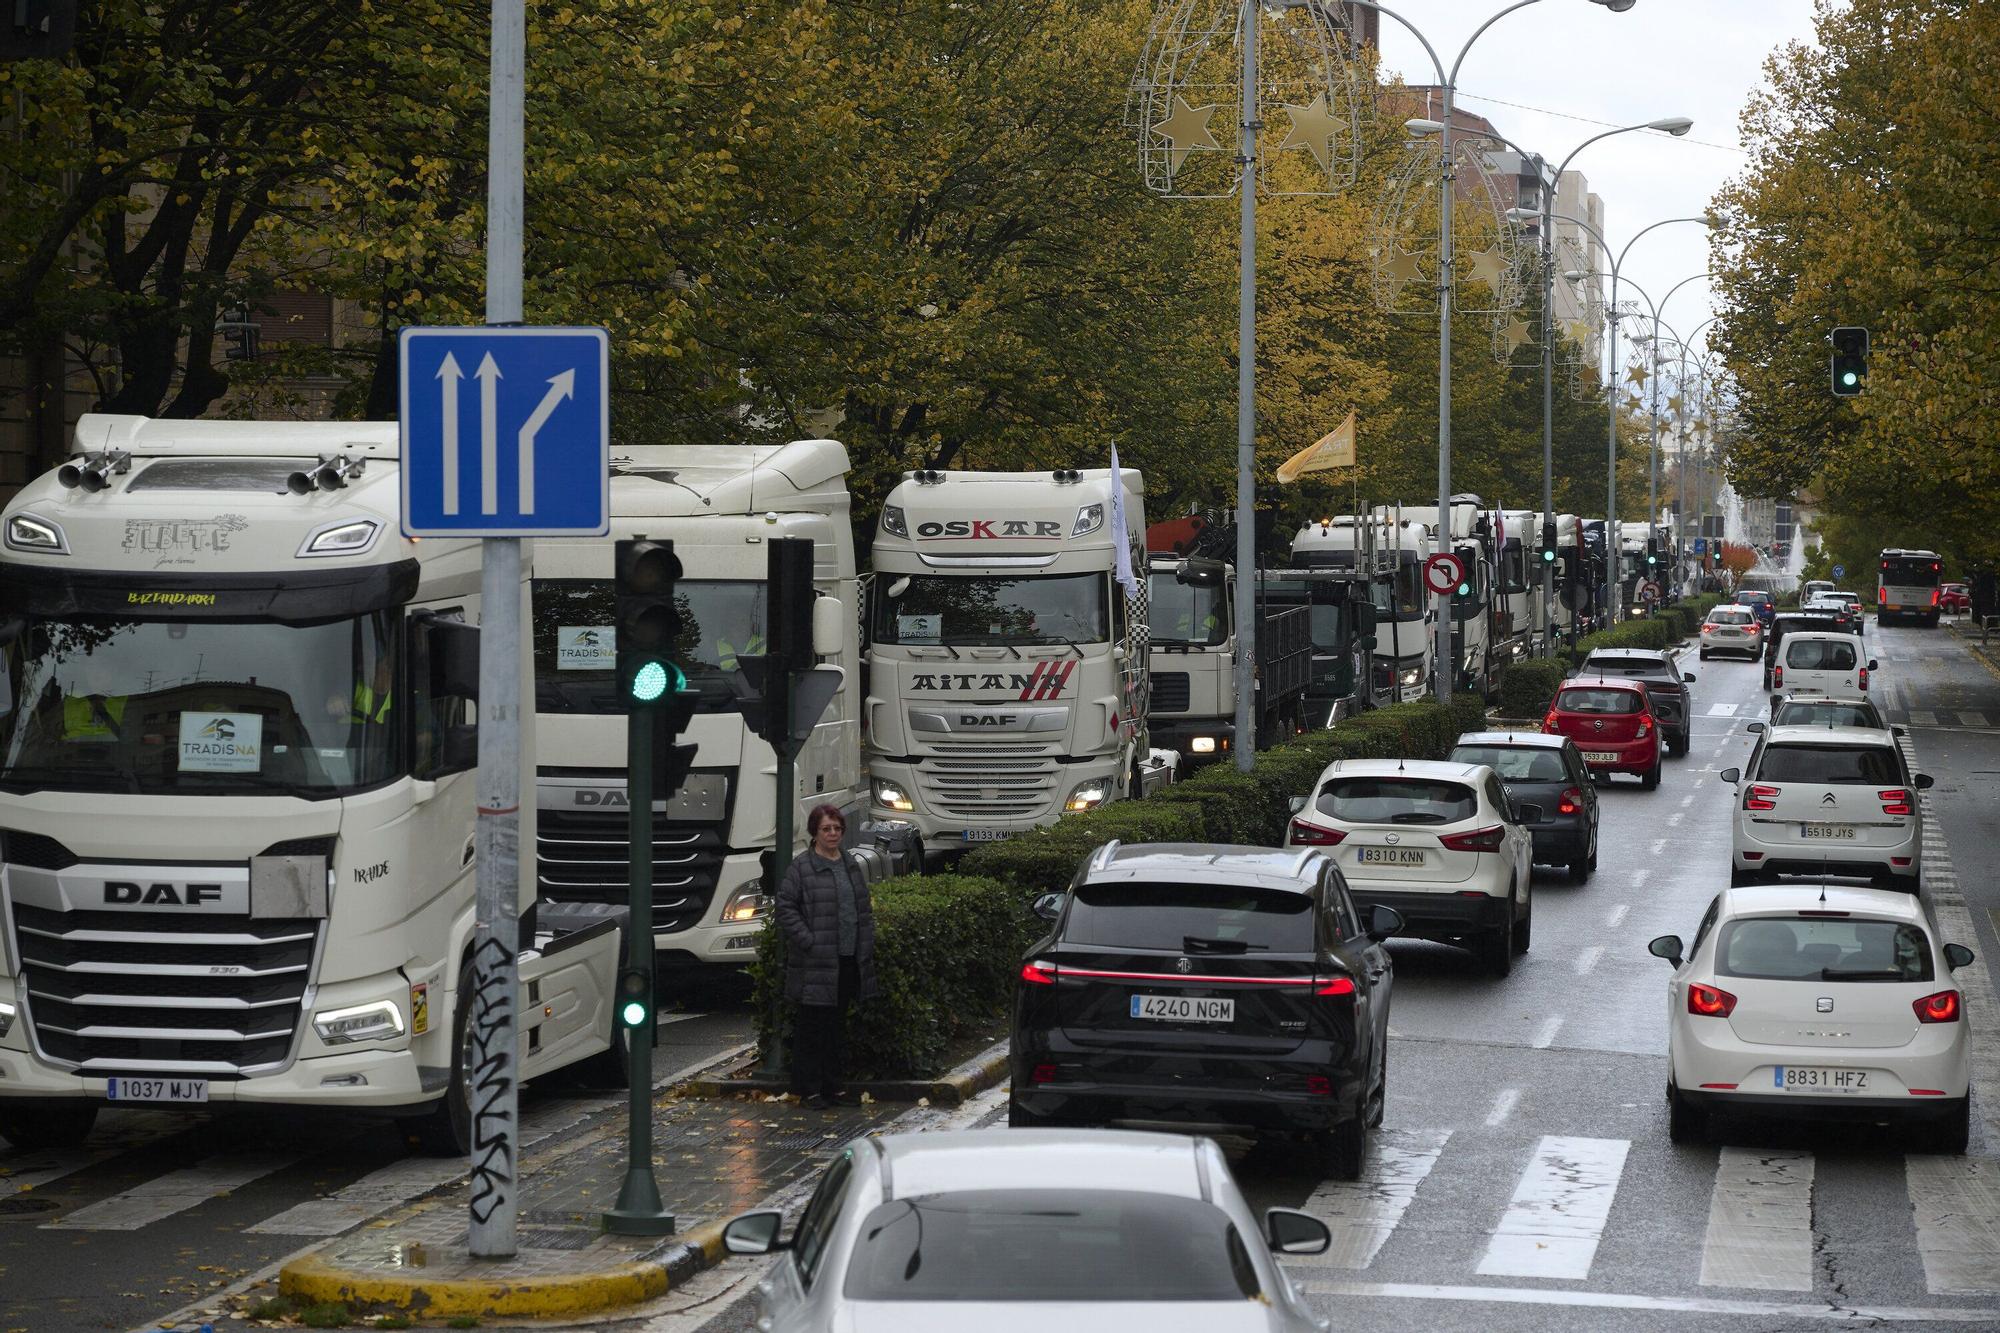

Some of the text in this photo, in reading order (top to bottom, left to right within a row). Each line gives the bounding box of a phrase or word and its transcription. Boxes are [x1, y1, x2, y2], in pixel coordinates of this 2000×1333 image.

[917, 520, 1061, 539] OSKAR
[960, 716, 1017, 726] DAF
[575, 790, 629, 806] DA
[969, 830, 993, 840] 9133
[1807, 827, 1854, 838] 5519 JYS
[1366, 850, 1424, 863] 8310 KNN
[104, 881, 222, 905] DAF
[1145, 998, 1231, 1020] 4240 NGM
[1787, 1070, 1867, 1088] 8831 HFZ
[122, 1081, 203, 1099] 1037 MJY
